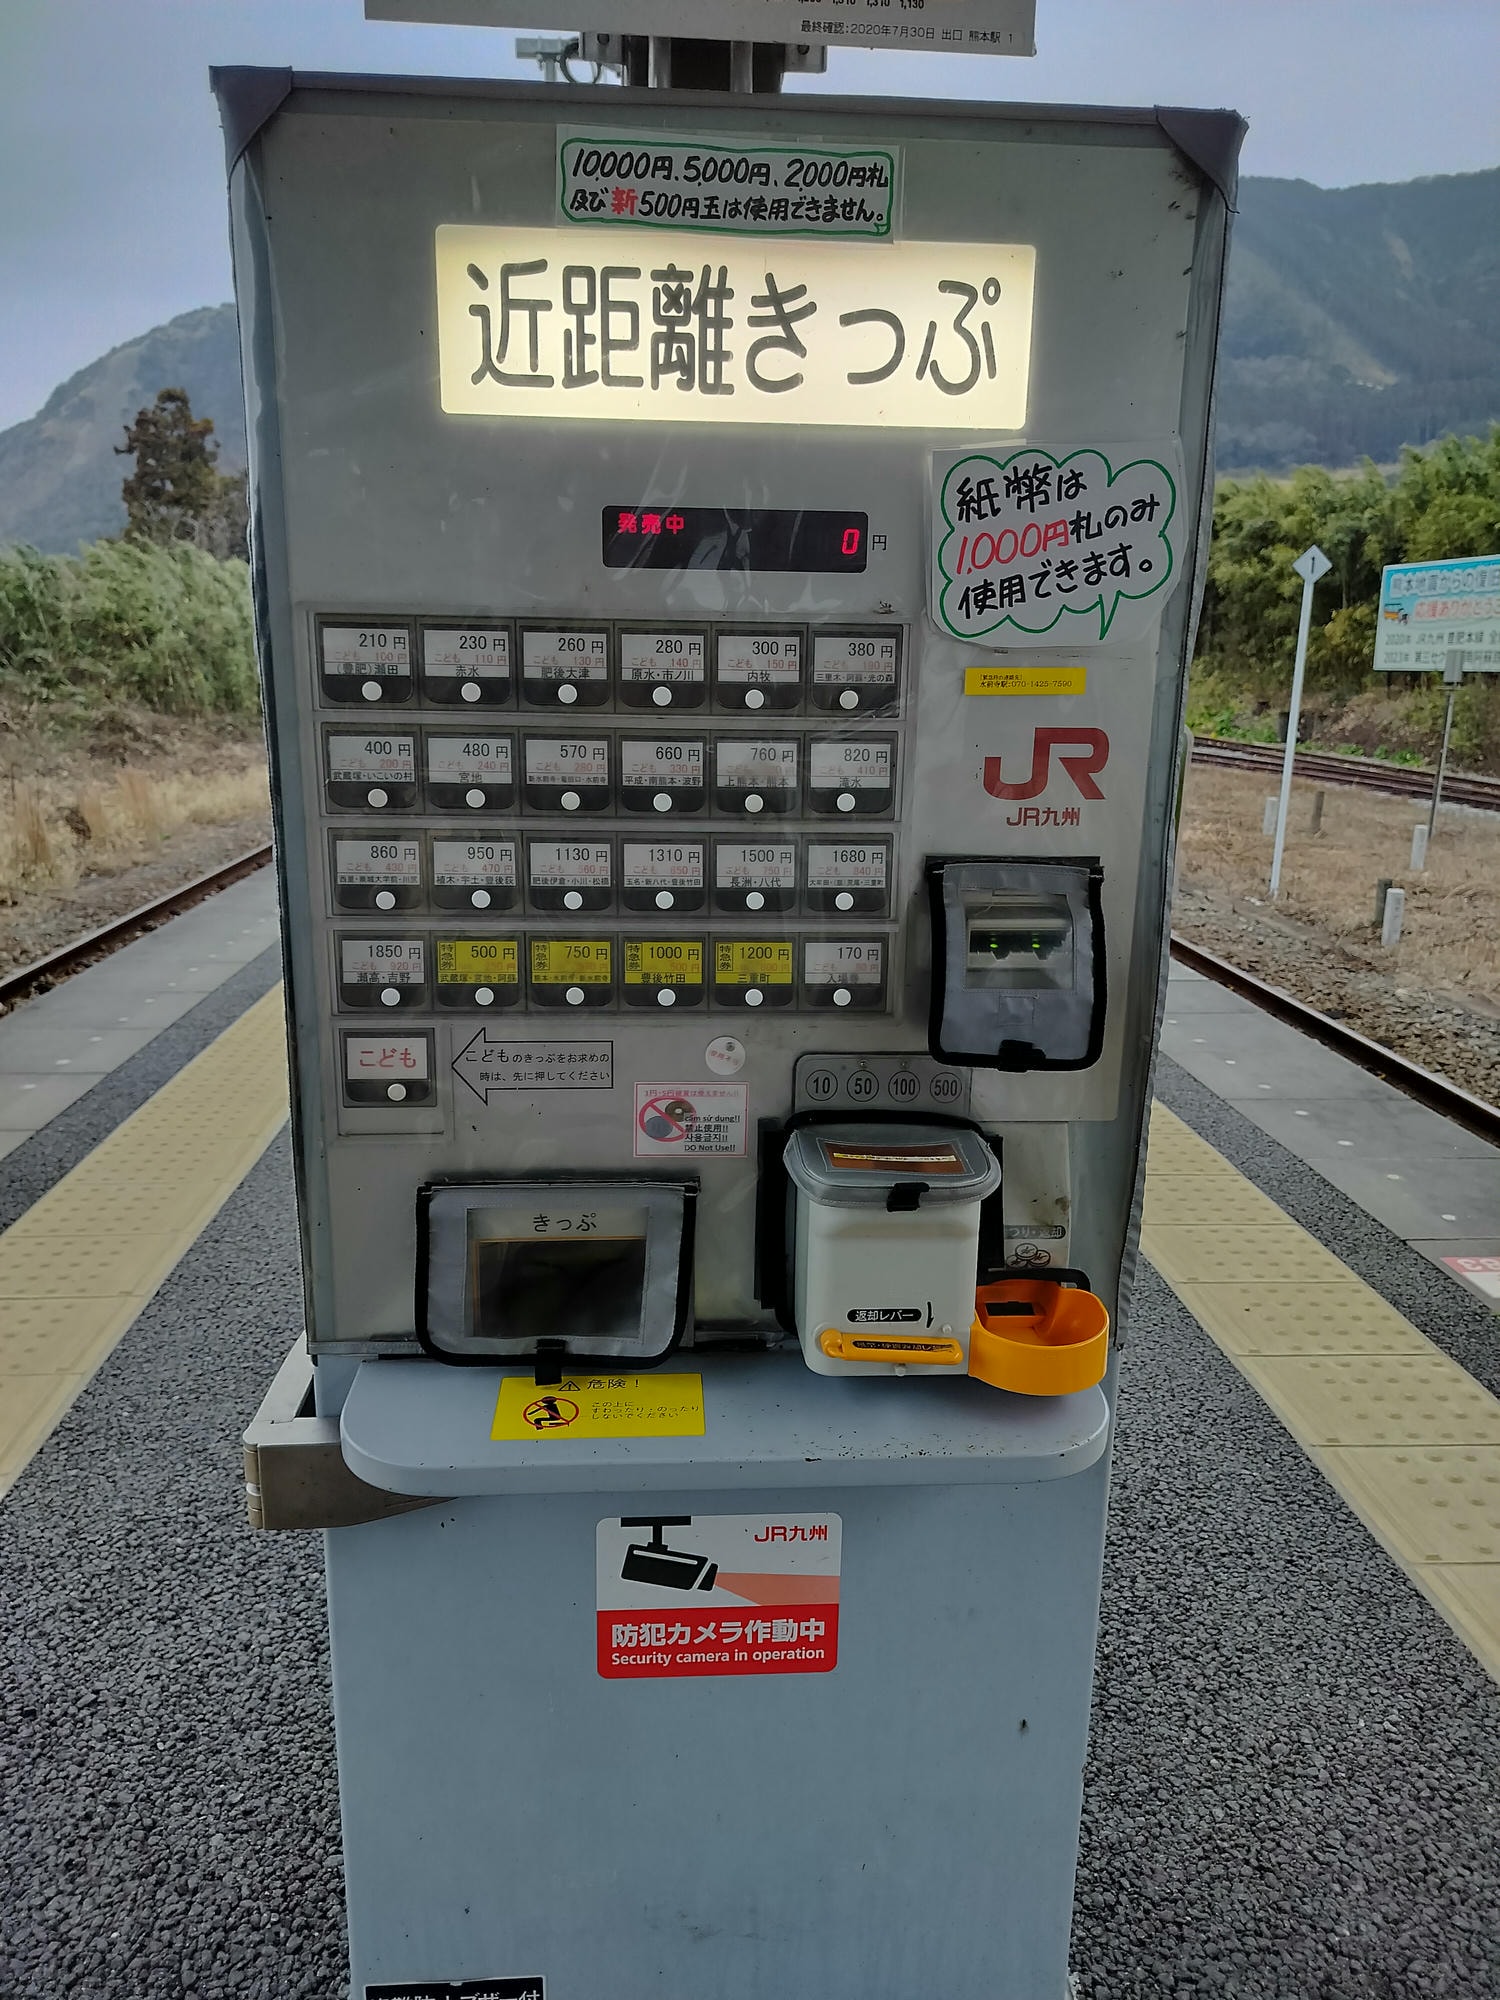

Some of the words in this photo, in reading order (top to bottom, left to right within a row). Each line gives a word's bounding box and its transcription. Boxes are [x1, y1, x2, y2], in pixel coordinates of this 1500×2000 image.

[801, 20, 935, 39] 最終確認:2020年7月30日
[941, 29, 963, 41] 出口
[968, 30, 1001, 44] 熊本駅
[466, 259, 1002, 397] 近距離きっぷ
[956, 463, 1088, 523] 紙幣は
[617, 512, 685, 535] 発売中
[841, 528, 860, 555] 0
[872, 534, 887, 550] 円
[956, 494, 1160, 575] 1,000円札のみ
[957, 543, 1153, 619] 使用できます。
[359, 633, 407, 650] 210円
[459, 635, 506, 651] 230円
[558, 637, 604, 653] 260円
[656, 639, 701, 656] 280円
[752, 641, 797, 657] 300円
[848, 642, 893, 658] 380円
[336, 664, 398, 675] (豊肥)瀬田
[455, 665, 480, 677] 赤水
[540, 666, 590, 679] 肥後大津
[631, 669, 694, 681] 原水・市ノ川
[747, 671, 771, 682] 内牧
[364, 740, 411, 757] 400円
[462, 743, 509, 759] 480円
[560, 744, 605, 760] 570円
[656, 746, 701, 762] 660円
[750, 747, 794, 763] 760円
[844, 748, 888, 764] 820円
[983, 727, 1110, 800] JR
[458, 772, 482, 784] 宮地
[1006, 807, 1081, 826] JR九州
[370, 845, 416, 861] 860円
[467, 847, 513, 862] 950円
[556, 847, 608, 862] 1130円
[648, 848, 700, 864] 1310円
[741, 849, 792, 864] 1500円
[833, 850, 884, 865] 1680円
[729, 876, 782, 888] 長洲・八代
[367, 945, 421, 959] 1850円
[471, 945, 515, 960] 500円
[564, 945, 608, 960] 750円
[649, 946, 699, 961] 1000円
[739, 946, 789, 961] 1200円
[838, 946, 879, 961] 170円
[641, 973, 686, 984] 豊後竹田
[358, 1047, 417, 1069] こども
[479, 1071, 611, 1082] 時は、先に押してください
[813, 1076, 831, 1094] 10
[854, 1077, 872, 1094] 50
[893, 1078, 916, 1096] 100
[934, 1078, 958, 1097] 500
[532, 1211, 598, 1233] きっぷ
[856, 1309, 914, 1322] 返却レバー
[754, 1525, 828, 1543] JR九州
[611, 1618, 826, 1648] 防犯カメラ作動中
[611, 1651, 672, 1666] Security
[676, 1651, 730, 1662] camera
[734, 1649, 748, 1661] in
[752, 1647, 825, 1663] operation
